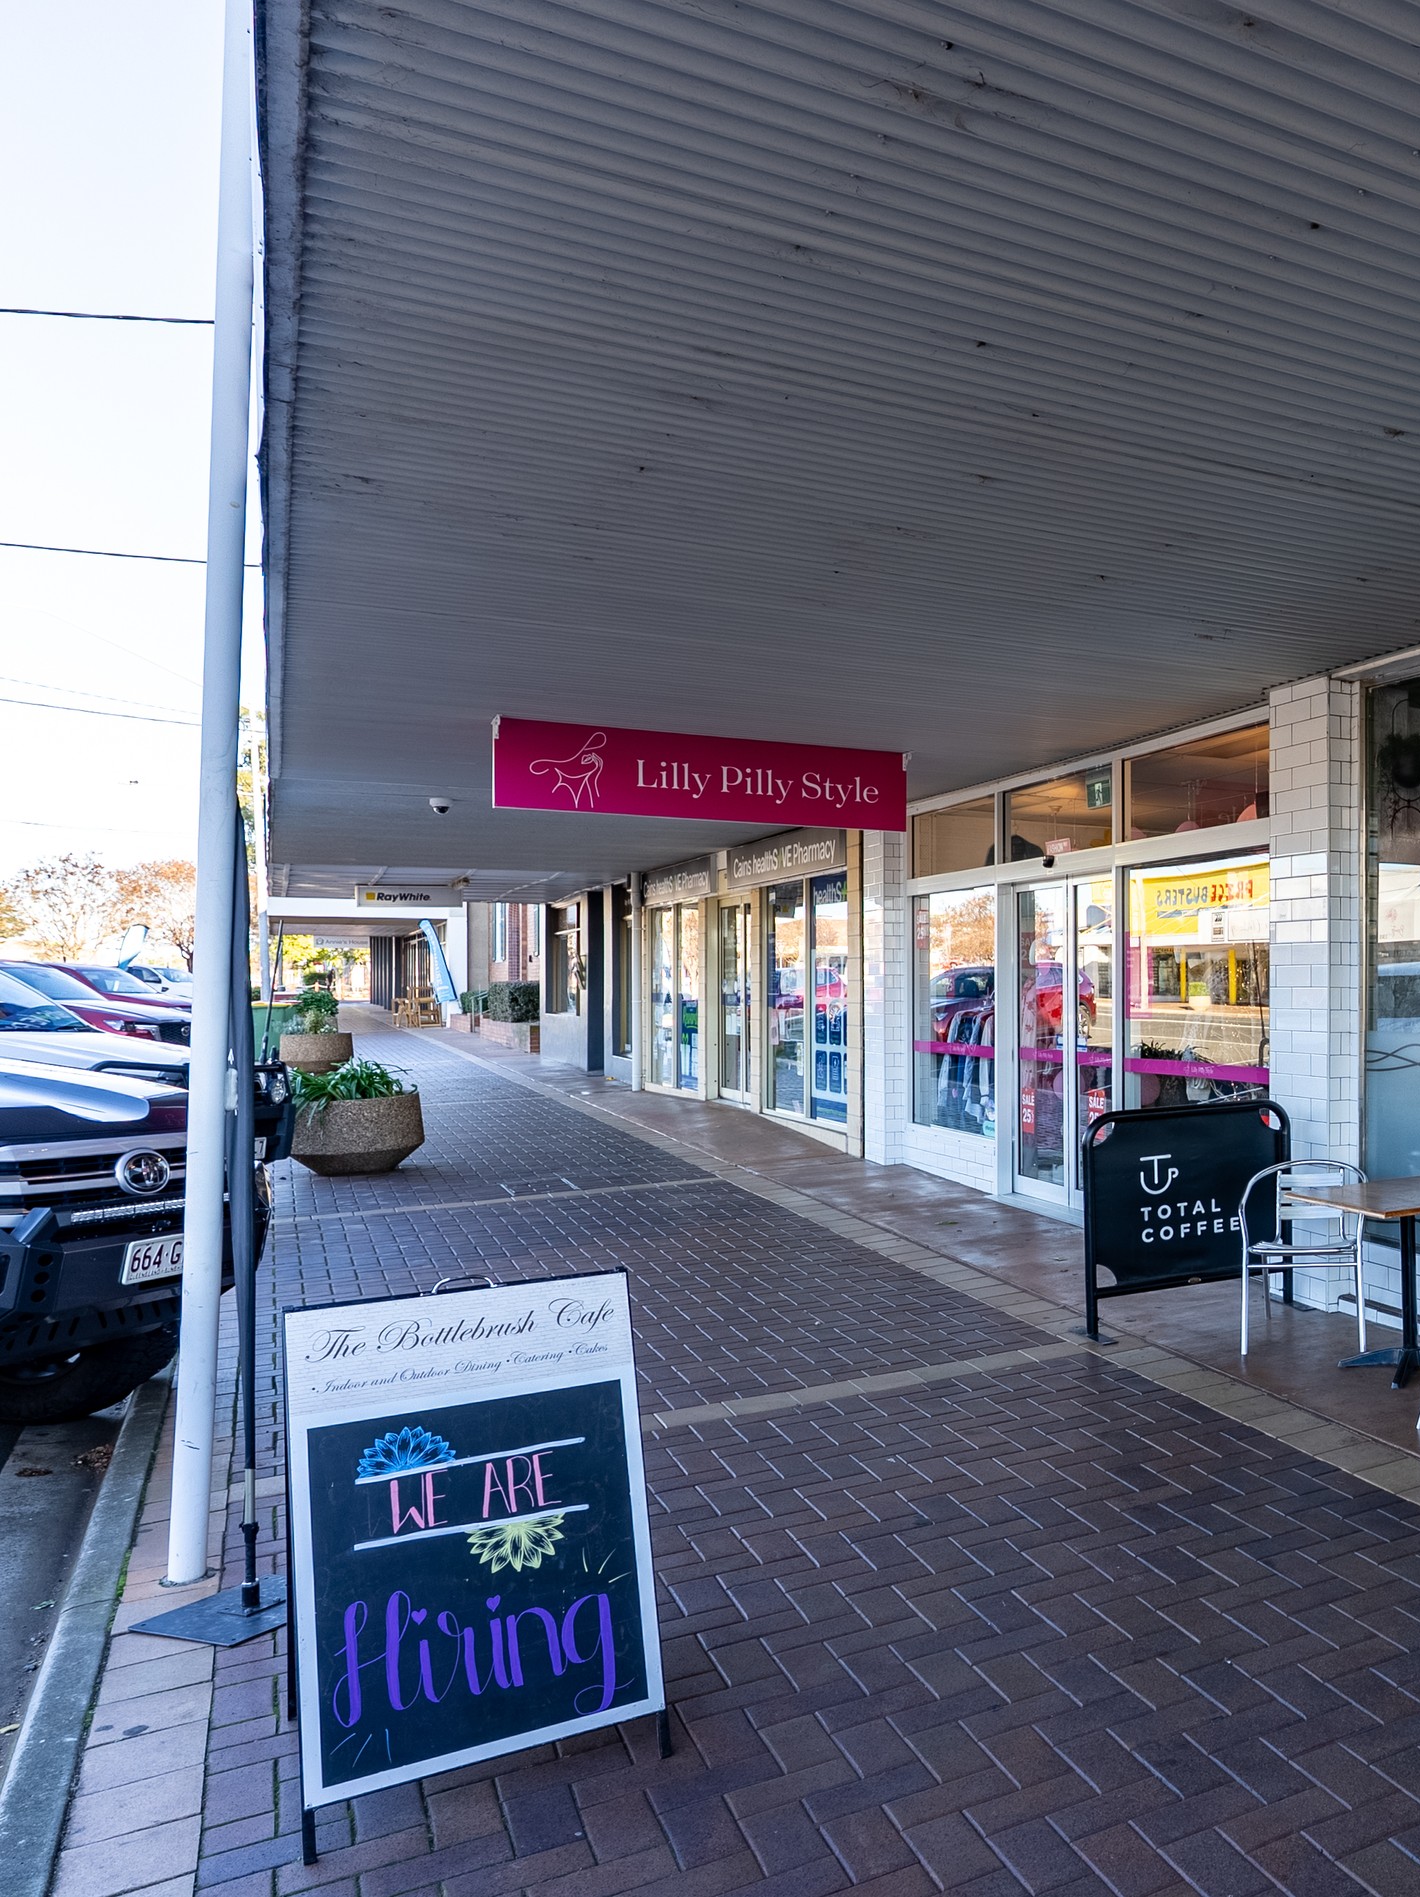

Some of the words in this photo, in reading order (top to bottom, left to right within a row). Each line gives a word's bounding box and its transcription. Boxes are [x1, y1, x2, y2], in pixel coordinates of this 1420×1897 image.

[636, 758, 711, 799] Lilly
[720, 765, 794, 804] Pilly
[801, 772, 880, 808] Style
[733, 856, 752, 878] Cains
[793, 840, 836, 866] Pharmacy
[643, 880, 656, 898] Cains
[682, 870, 710, 892] Pharmacy
[1022, 1092, 1035, 1106] SALE
[1088, 1094, 1105, 1109] SALE
[1140, 1198, 1222, 1222] TOTAL
[1141, 1216, 1240, 1243] COFFEE
[305, 1325, 367, 1363] The
[377, 1310, 539, 1352] Bottlebrush
[548, 1297, 616, 1334] Cafe
[370, 1371, 399, 1386] and
[399, 1366, 450, 1383] Outdoor
[454, 1357, 502, 1375] Dining
[390, 1469, 449, 1534] WE
[482, 1450, 563, 1518] ARE
[332, 1590, 636, 1728] Hiring
